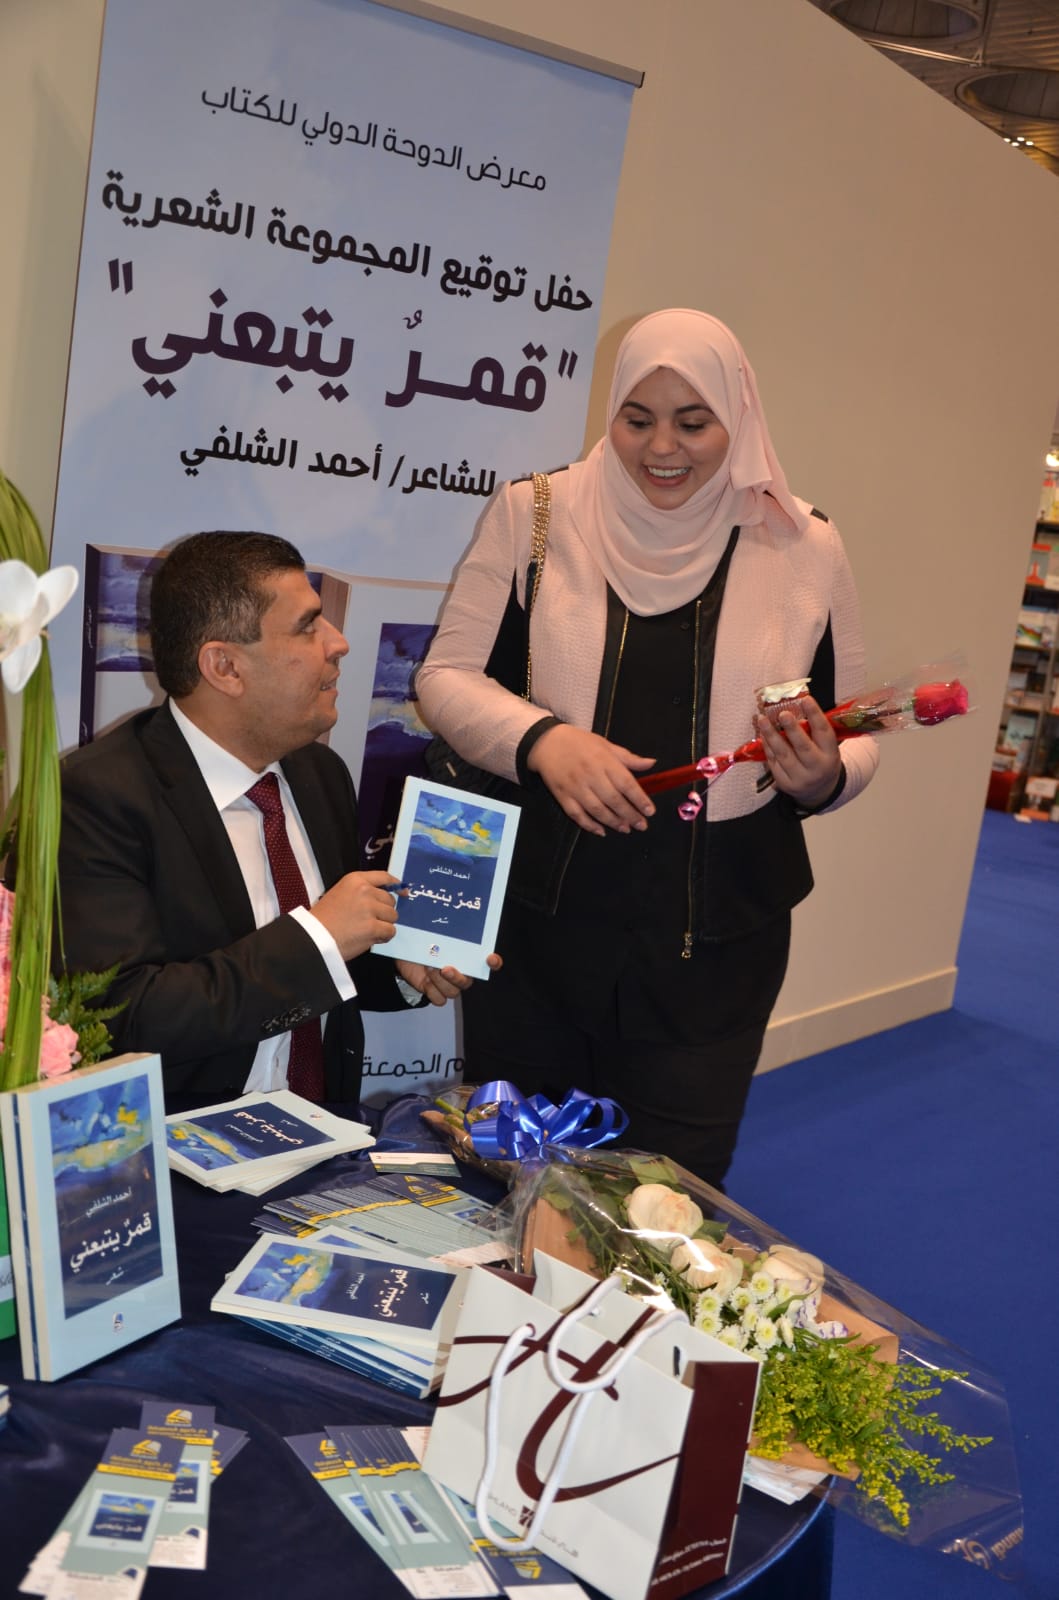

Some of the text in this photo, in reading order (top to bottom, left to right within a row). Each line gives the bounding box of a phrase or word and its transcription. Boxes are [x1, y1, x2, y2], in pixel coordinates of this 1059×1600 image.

[201, 86, 547, 191] معرض الدوحة الدولي للكتاب
[102, 169, 593, 312] حفل توقيع المجموعة الشعرية
[179, 425, 496, 498] للشاعر/ أحمد الشلفي
[70, 1228, 120, 1274] يتبعني
